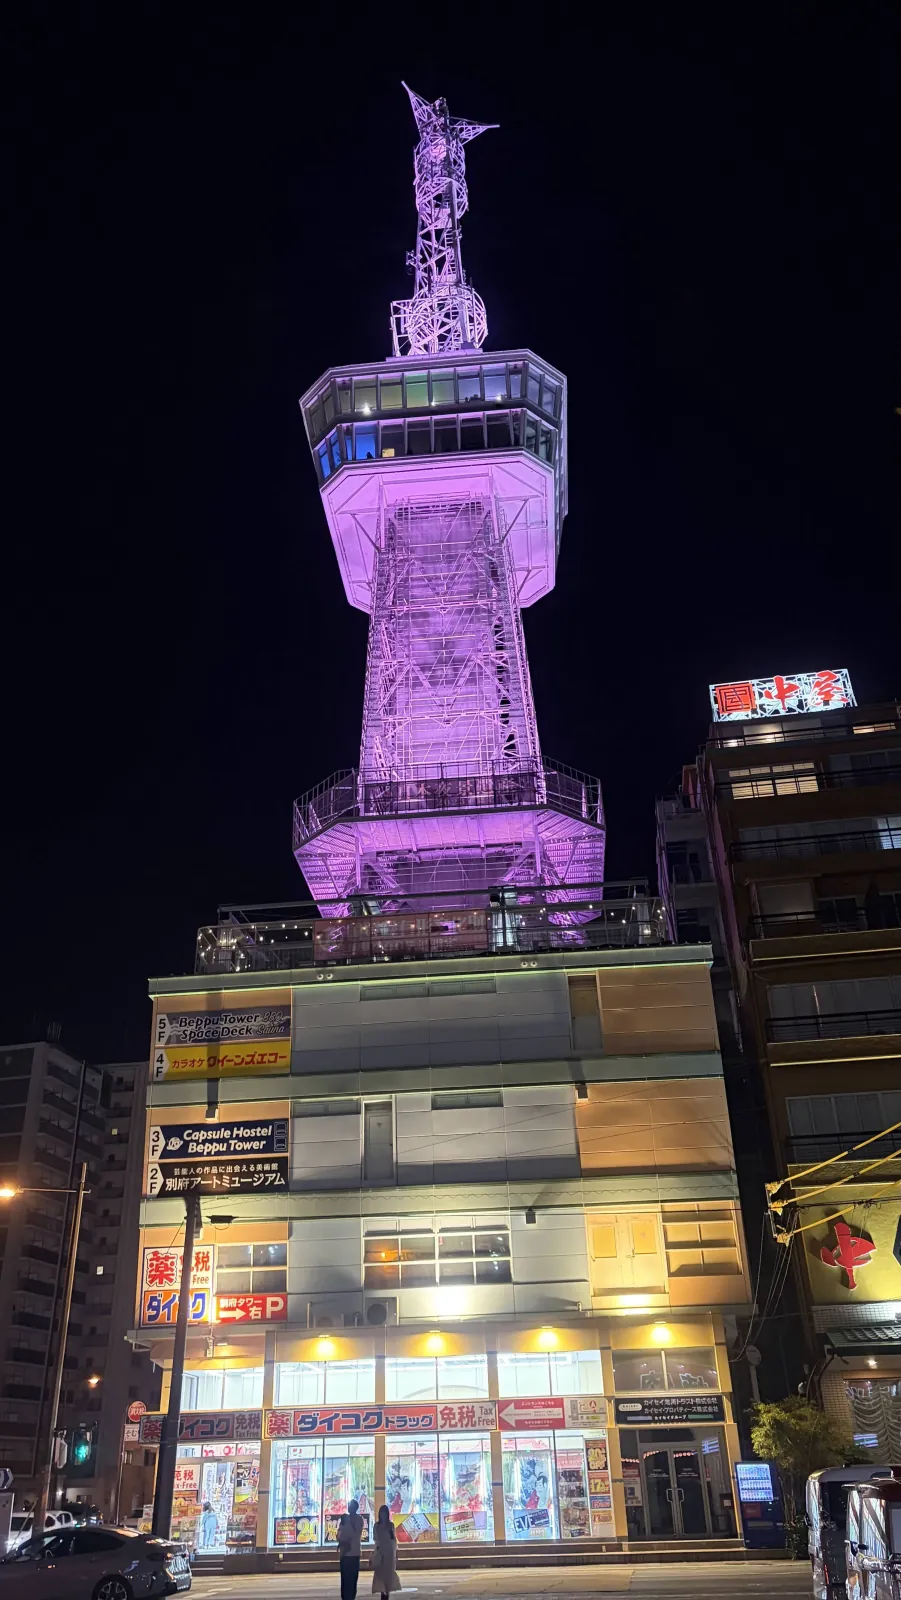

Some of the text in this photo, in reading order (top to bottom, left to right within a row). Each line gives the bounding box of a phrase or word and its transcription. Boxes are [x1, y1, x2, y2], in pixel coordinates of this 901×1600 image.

[179, 1013, 260, 1030] Beppu Tower
[180, 1025, 253, 1042] Space Deck
[171, 1051, 287, 1069] カラオケ クイーンズエコー
[183, 1125, 272, 1142] Capsule Hostel
[188, 1140, 266, 1155] Beppu Tower
[165, 1172, 286, 1191] 別府アートミュージアム
[148, 1251, 177, 1286] 薬
[147, 1292, 206, 1321] ダイク
[249, 1306, 262, 1320] 右
[266, 1297, 284, 1319] P
[479, 1406, 493, 1415] Tax
[236, 1413, 260, 1430] 免税
[269, 1405, 477, 1435] 薬 ダイコク ドラッグ 免税
[478, 1417, 495, 1426] Free
